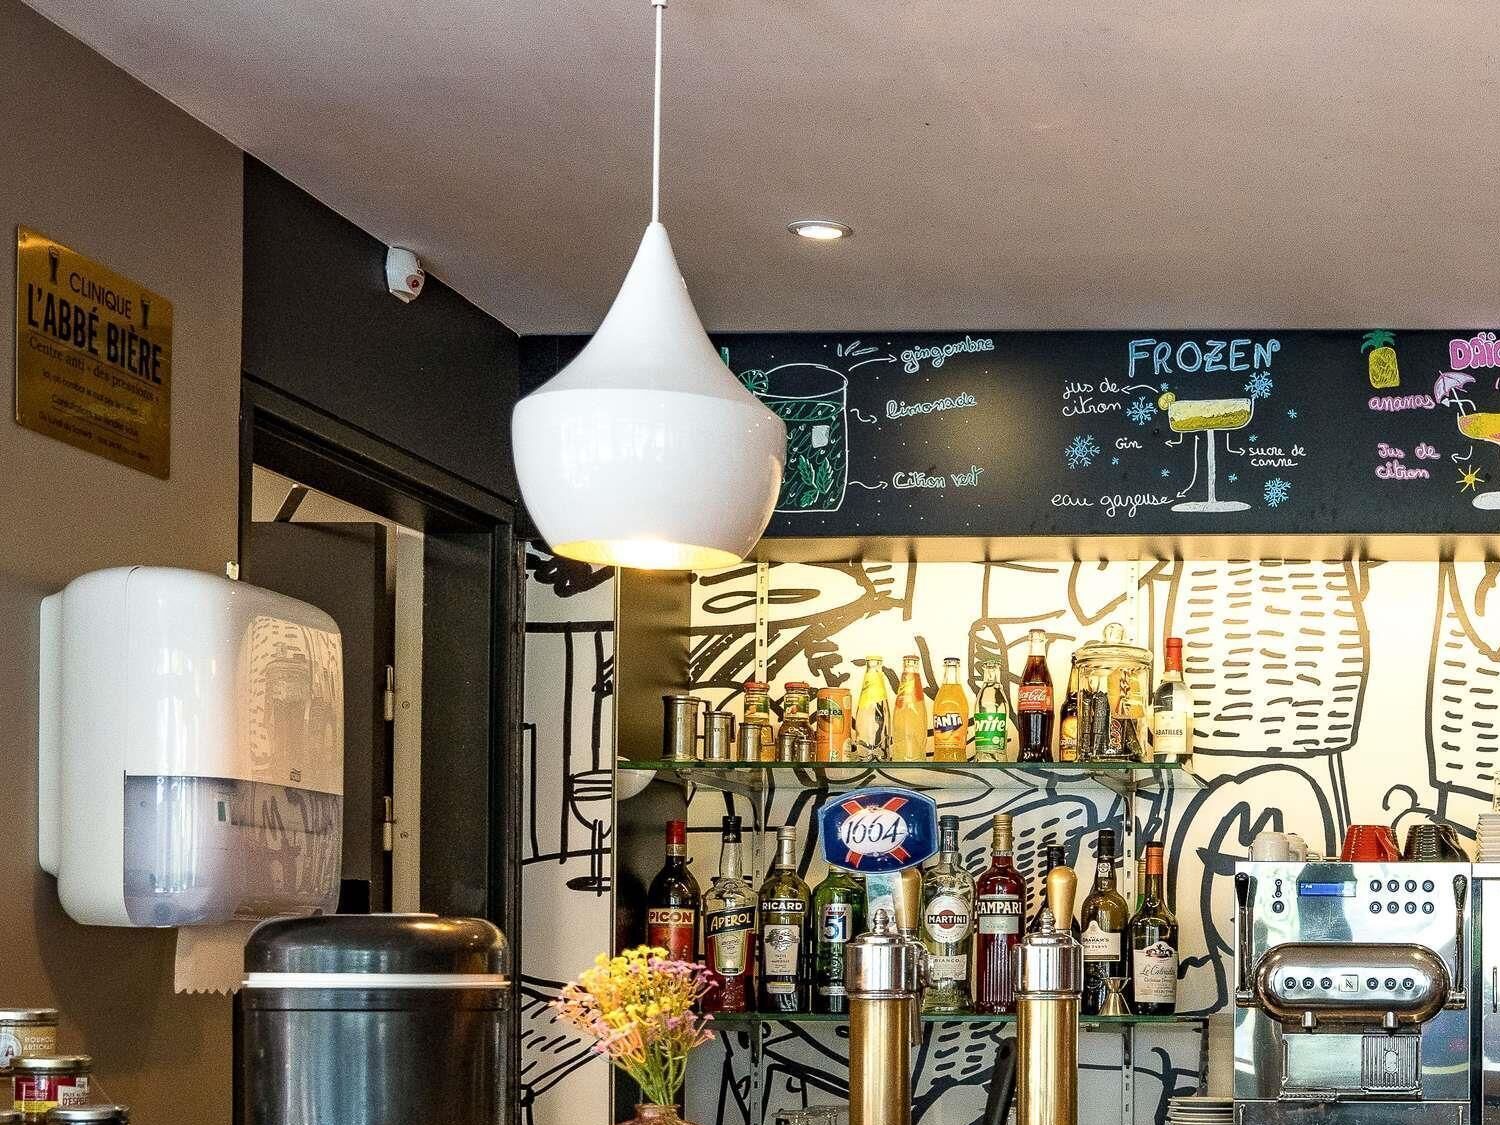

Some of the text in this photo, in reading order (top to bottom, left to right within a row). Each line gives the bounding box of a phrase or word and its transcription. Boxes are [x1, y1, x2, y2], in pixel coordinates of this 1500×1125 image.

[69, 272, 132, 320] CLINIQUE
[27, 283, 162, 385] L'ABBÉ BIÈRE
[901, 337, 994, 373] gingembre
[1128, 339, 1281, 377] FROZEN
[1063, 378, 1121, 399] jus de
[886, 392, 977, 419] limonade
[1062, 397, 1122, 417] citron
[1368, 394, 1435, 412] ananas
[1115, 437, 1142, 450] Gin
[1248, 444, 1307, 457] sucre de
[1377, 442, 1441, 460] Jus de
[1251, 456, 1299, 468] canne
[1375, 461, 1430, 480] citron
[893, 472, 946, 489] Citron
[1051, 492, 1174, 517] eau gazeuse
[933, 712, 963, 729] FANTA
[975, 715, 1005, 732] prite
[846, 816, 902, 844] 1664
[762, 902, 803, 912] RICARD
[977, 902, 1022, 914] CAMPARI
[648, 910, 692, 924] PICON
[710, 911, 751, 930] APEROL
[928, 915, 966, 923] MARTINI
[824, 915, 848, 942] 51
